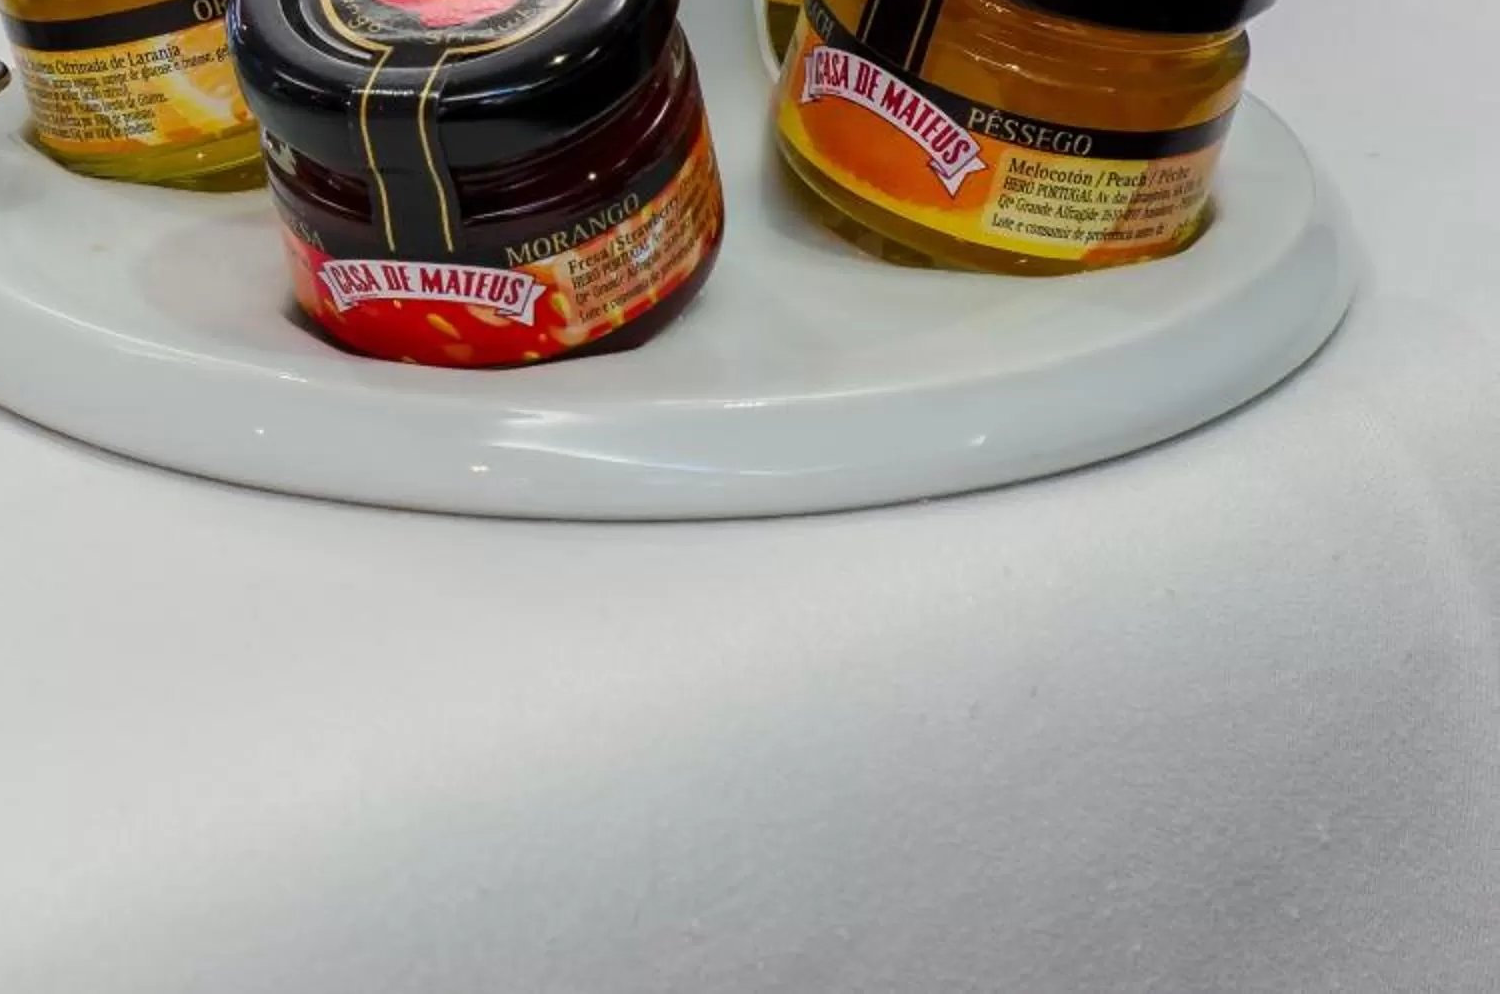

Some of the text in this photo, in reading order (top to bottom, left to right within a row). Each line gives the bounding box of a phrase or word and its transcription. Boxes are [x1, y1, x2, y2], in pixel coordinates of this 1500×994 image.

[110, 53, 126, 70] de
[127, 44, 182, 68] Laranja
[814, 51, 972, 166] CASA DE MATEUS
[966, 106, 1094, 157] PÊSSEGO
[1008, 157, 1093, 186] Melocotón
[1106, 170, 1147, 188] Peach
[505, 193, 640, 268] MORANGO
[334, 264, 525, 306] CASA DE MATEUS
